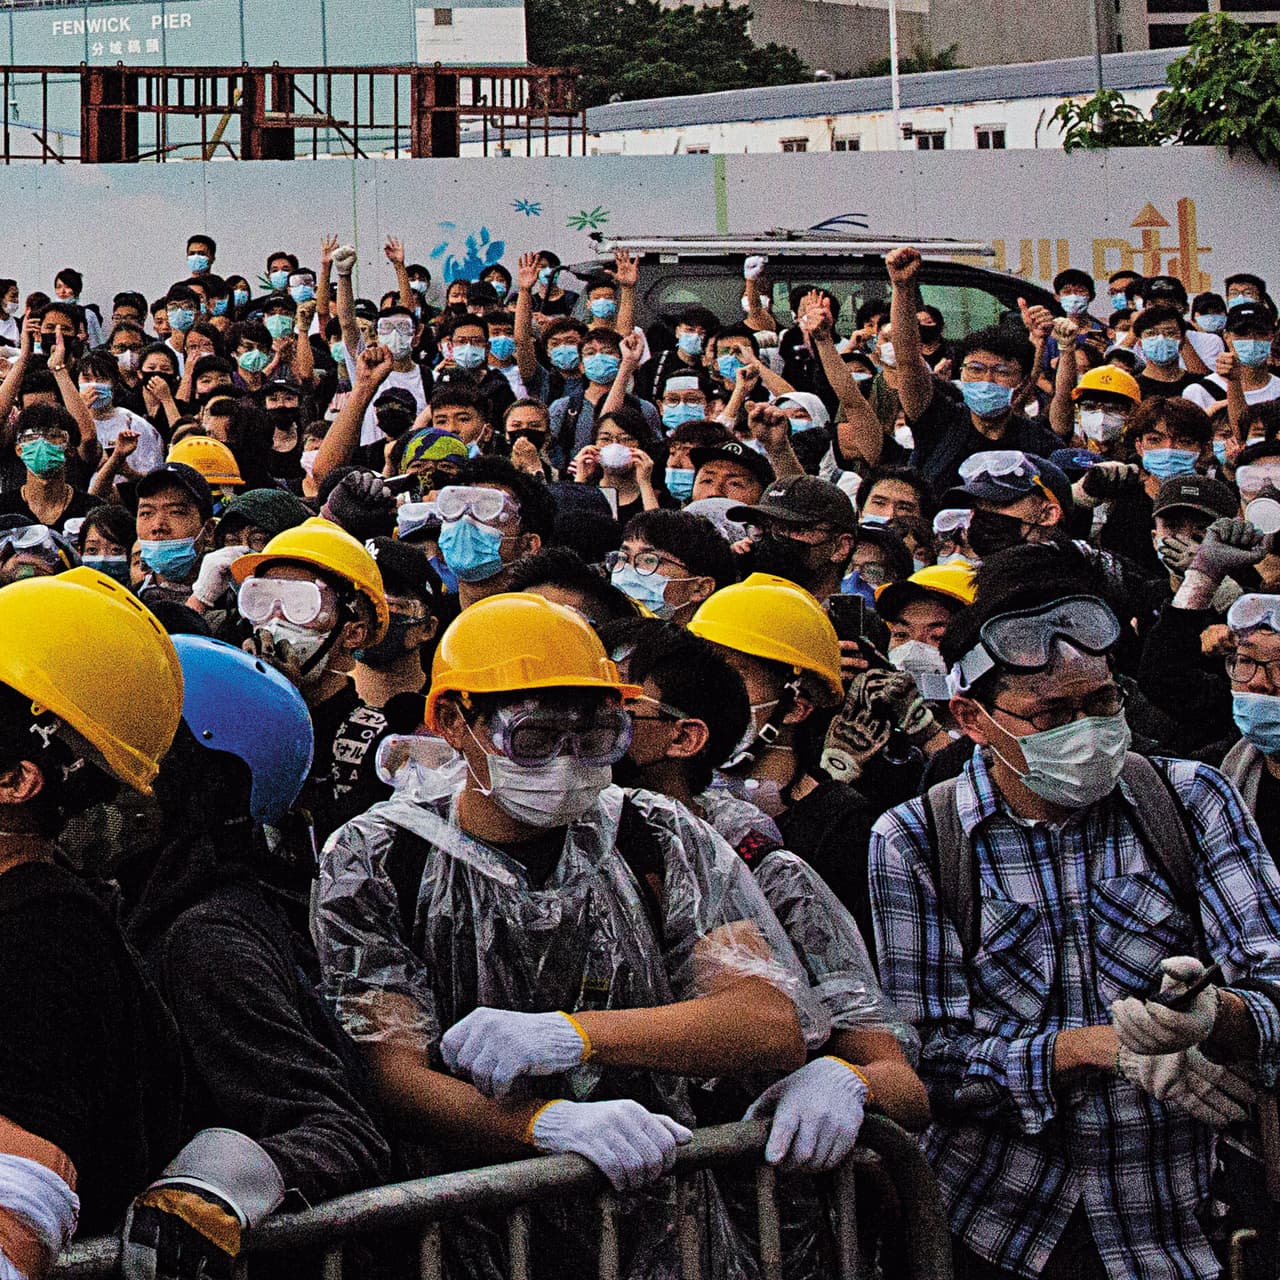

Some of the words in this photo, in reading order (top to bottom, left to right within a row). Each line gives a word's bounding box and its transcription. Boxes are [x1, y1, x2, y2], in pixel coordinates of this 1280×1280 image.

[52, 17, 131, 35] FENWICK
[151, 13, 192, 30] PIER
[92, 38, 160, 56] 分域碼頭
